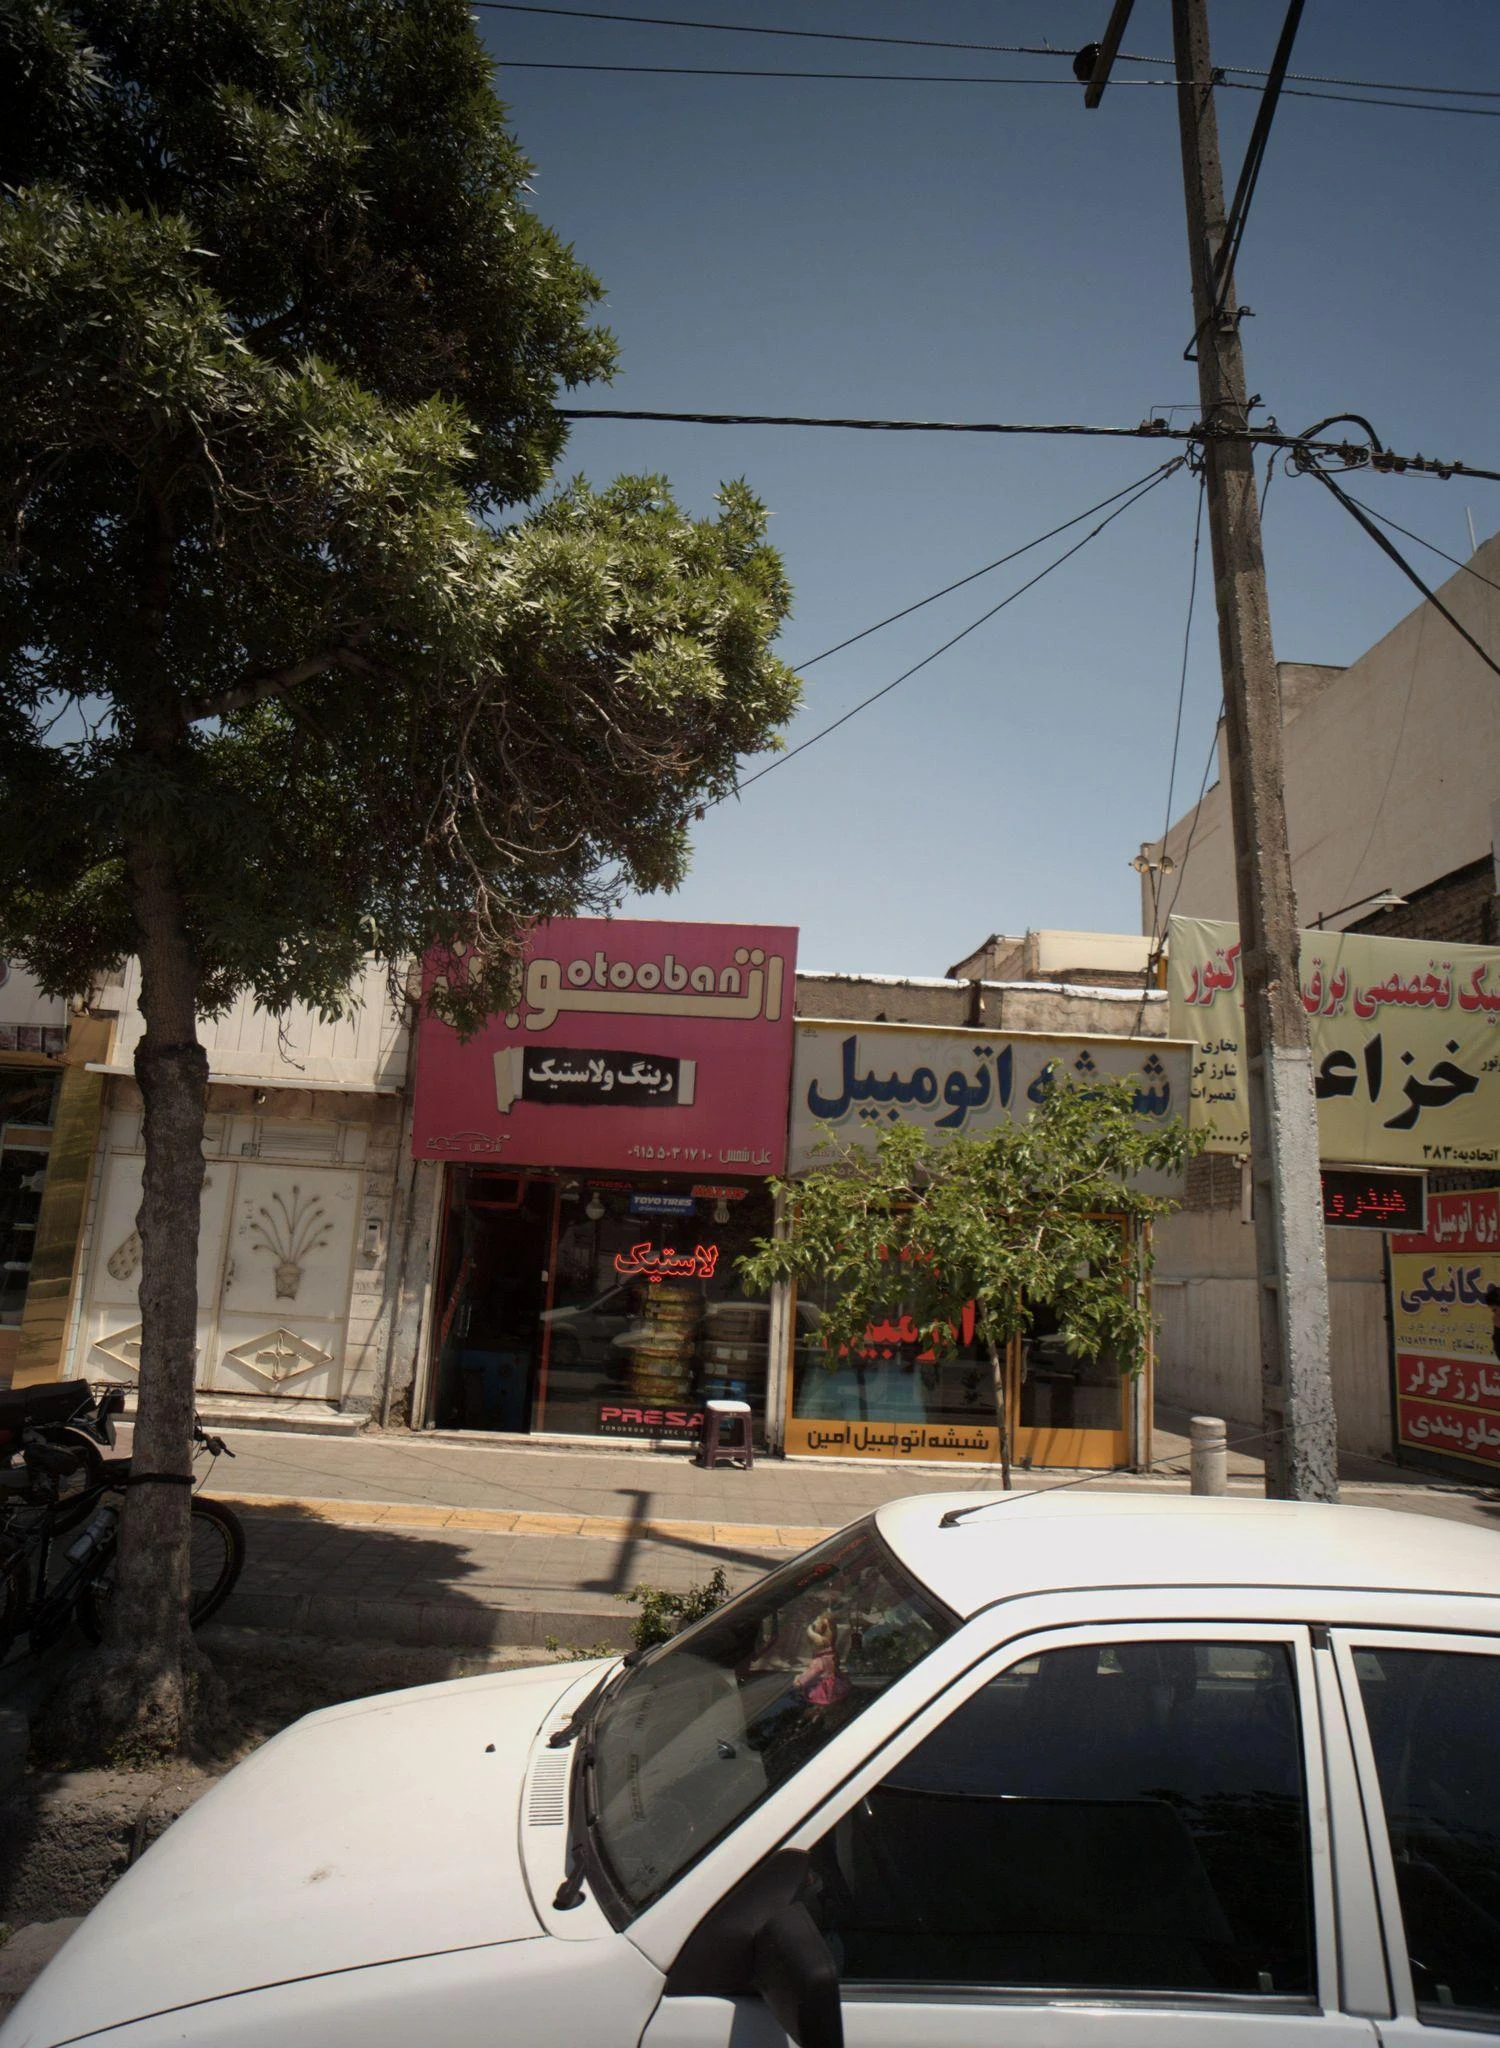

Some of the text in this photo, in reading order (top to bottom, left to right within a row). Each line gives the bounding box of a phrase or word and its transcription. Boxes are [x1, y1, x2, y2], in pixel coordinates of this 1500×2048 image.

[567, 951, 740, 994] otooban
[1301, 956, 1348, 1016] برق
[1353, 958, 1452, 1018] تخصصی
[1201, 1038, 1238, 1056] بخاری
[618, 1061, 673, 1094] رینگ
[807, 1035, 1013, 1128] اتومبیل
[1191, 1062, 1236, 1080] شارژ کو
[1315, 1033, 1480, 1130] خزاع
[1190, 1086, 1236, 1104] تعمیرات
[751, 1150, 772, 1165] علی
[1433, 1200, 1473, 1244] اتومبیل
[1474, 1204, 1498, 1244] برق
[614, 1241, 719, 1283] لاستیک
[1405, 1360, 1452, 1396] کولر
[807, 1426, 989, 1456] شیشه اتومبیل امین
